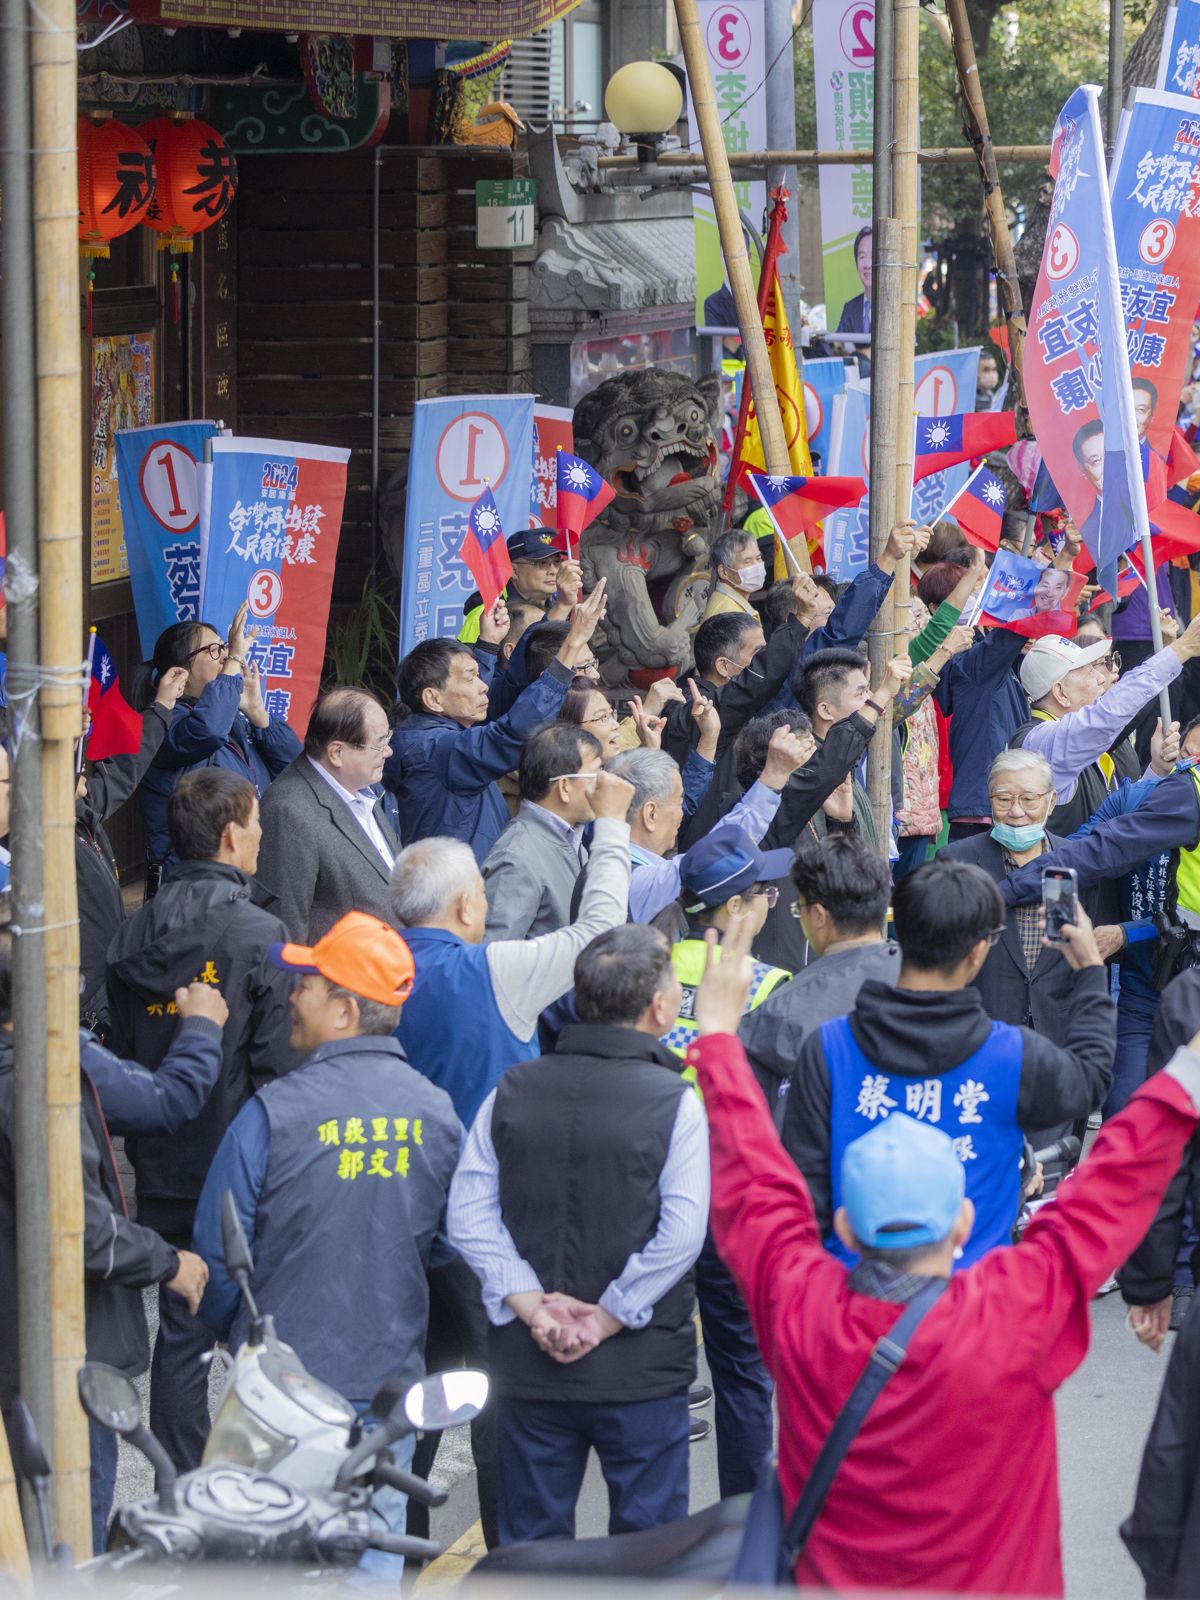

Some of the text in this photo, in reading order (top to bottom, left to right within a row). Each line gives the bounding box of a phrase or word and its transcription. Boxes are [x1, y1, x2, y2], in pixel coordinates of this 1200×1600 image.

[1147, 223, 1169, 259] 3
[1126, 329, 1167, 368] 少康
[157, 451, 187, 517] 1
[262, 462, 299, 491] 2024
[228, 500, 327, 536] 台灣再出發
[225, 532, 318, 565] 人民有侯康
[255, 574, 274, 610] 3
[246, 641, 296, 679] 友宜
[854, 1074, 990, 1125] 蔡明堂
